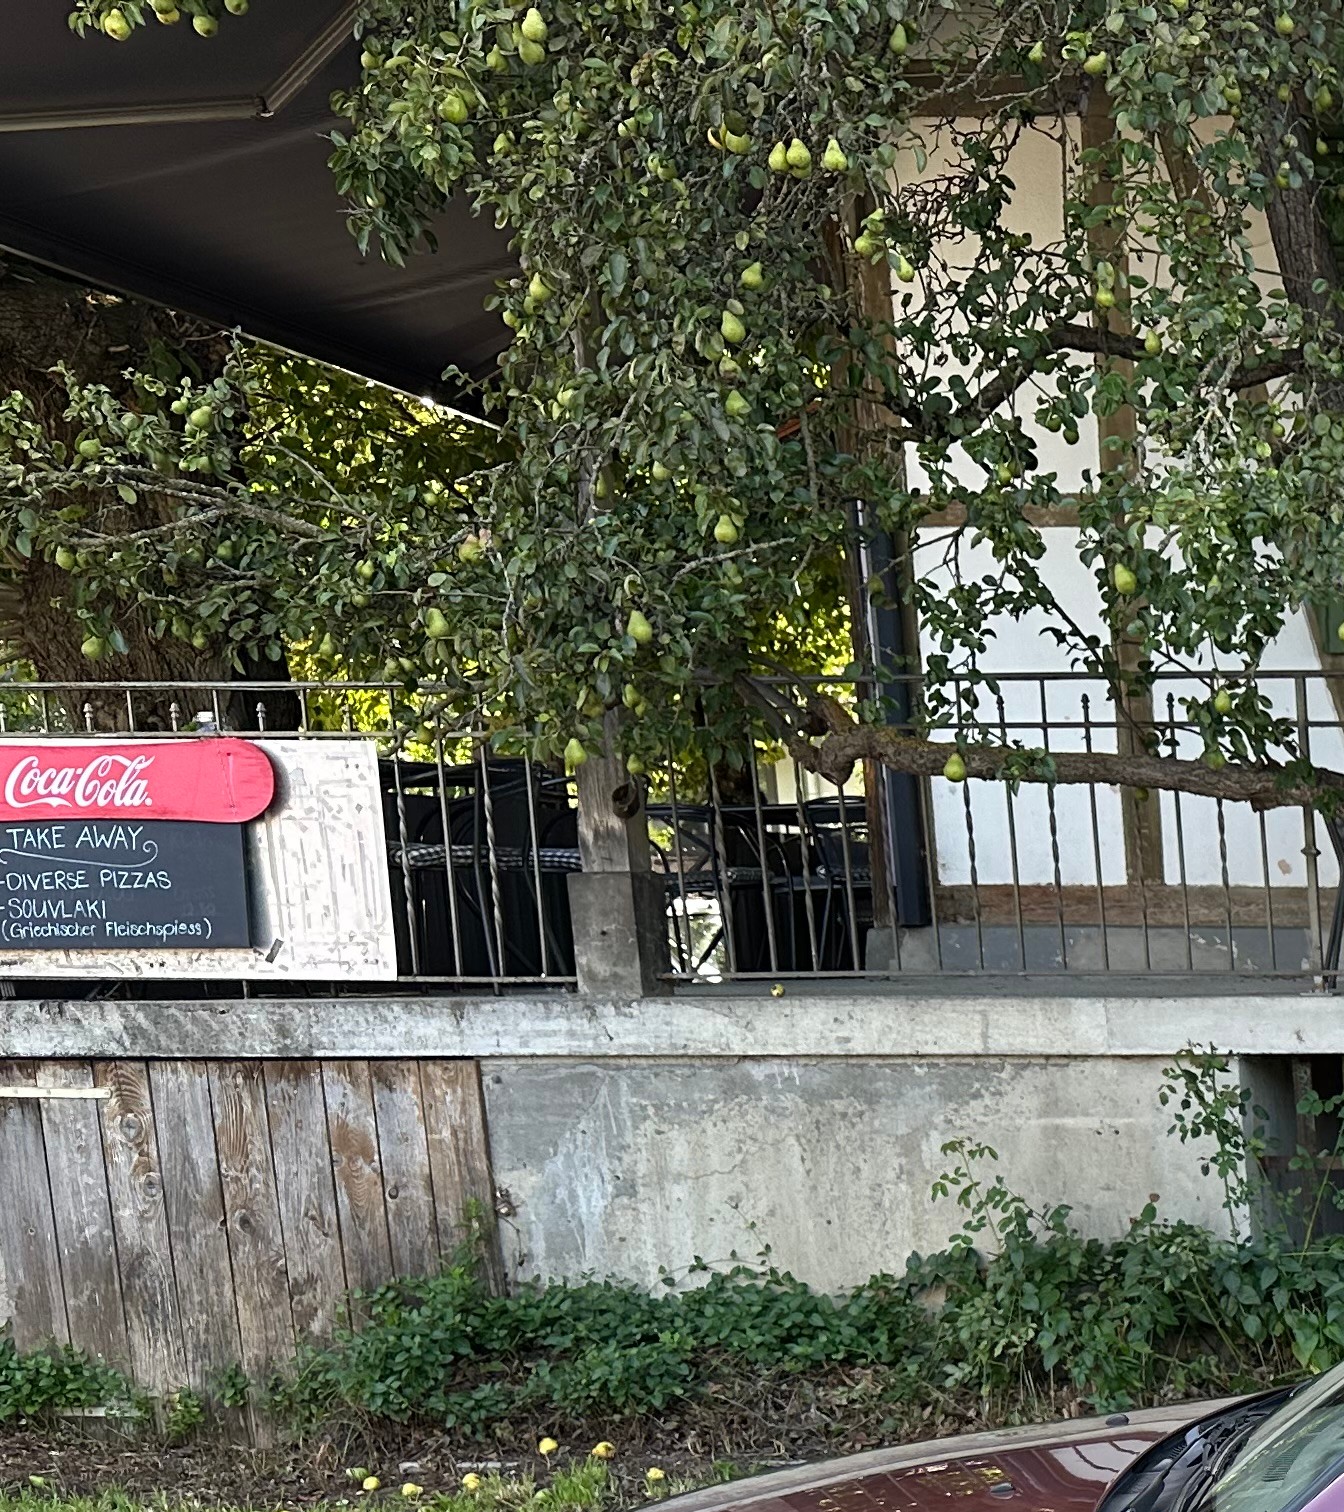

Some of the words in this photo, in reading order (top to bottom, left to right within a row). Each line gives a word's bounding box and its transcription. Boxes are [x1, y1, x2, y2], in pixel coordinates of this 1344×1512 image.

[4, 754, 156, 808] Coca-Cola
[6, 826, 66, 849] TAKE
[75, 824, 144, 850] AWAY
[100, 869, 172, 889] PIZZAS
